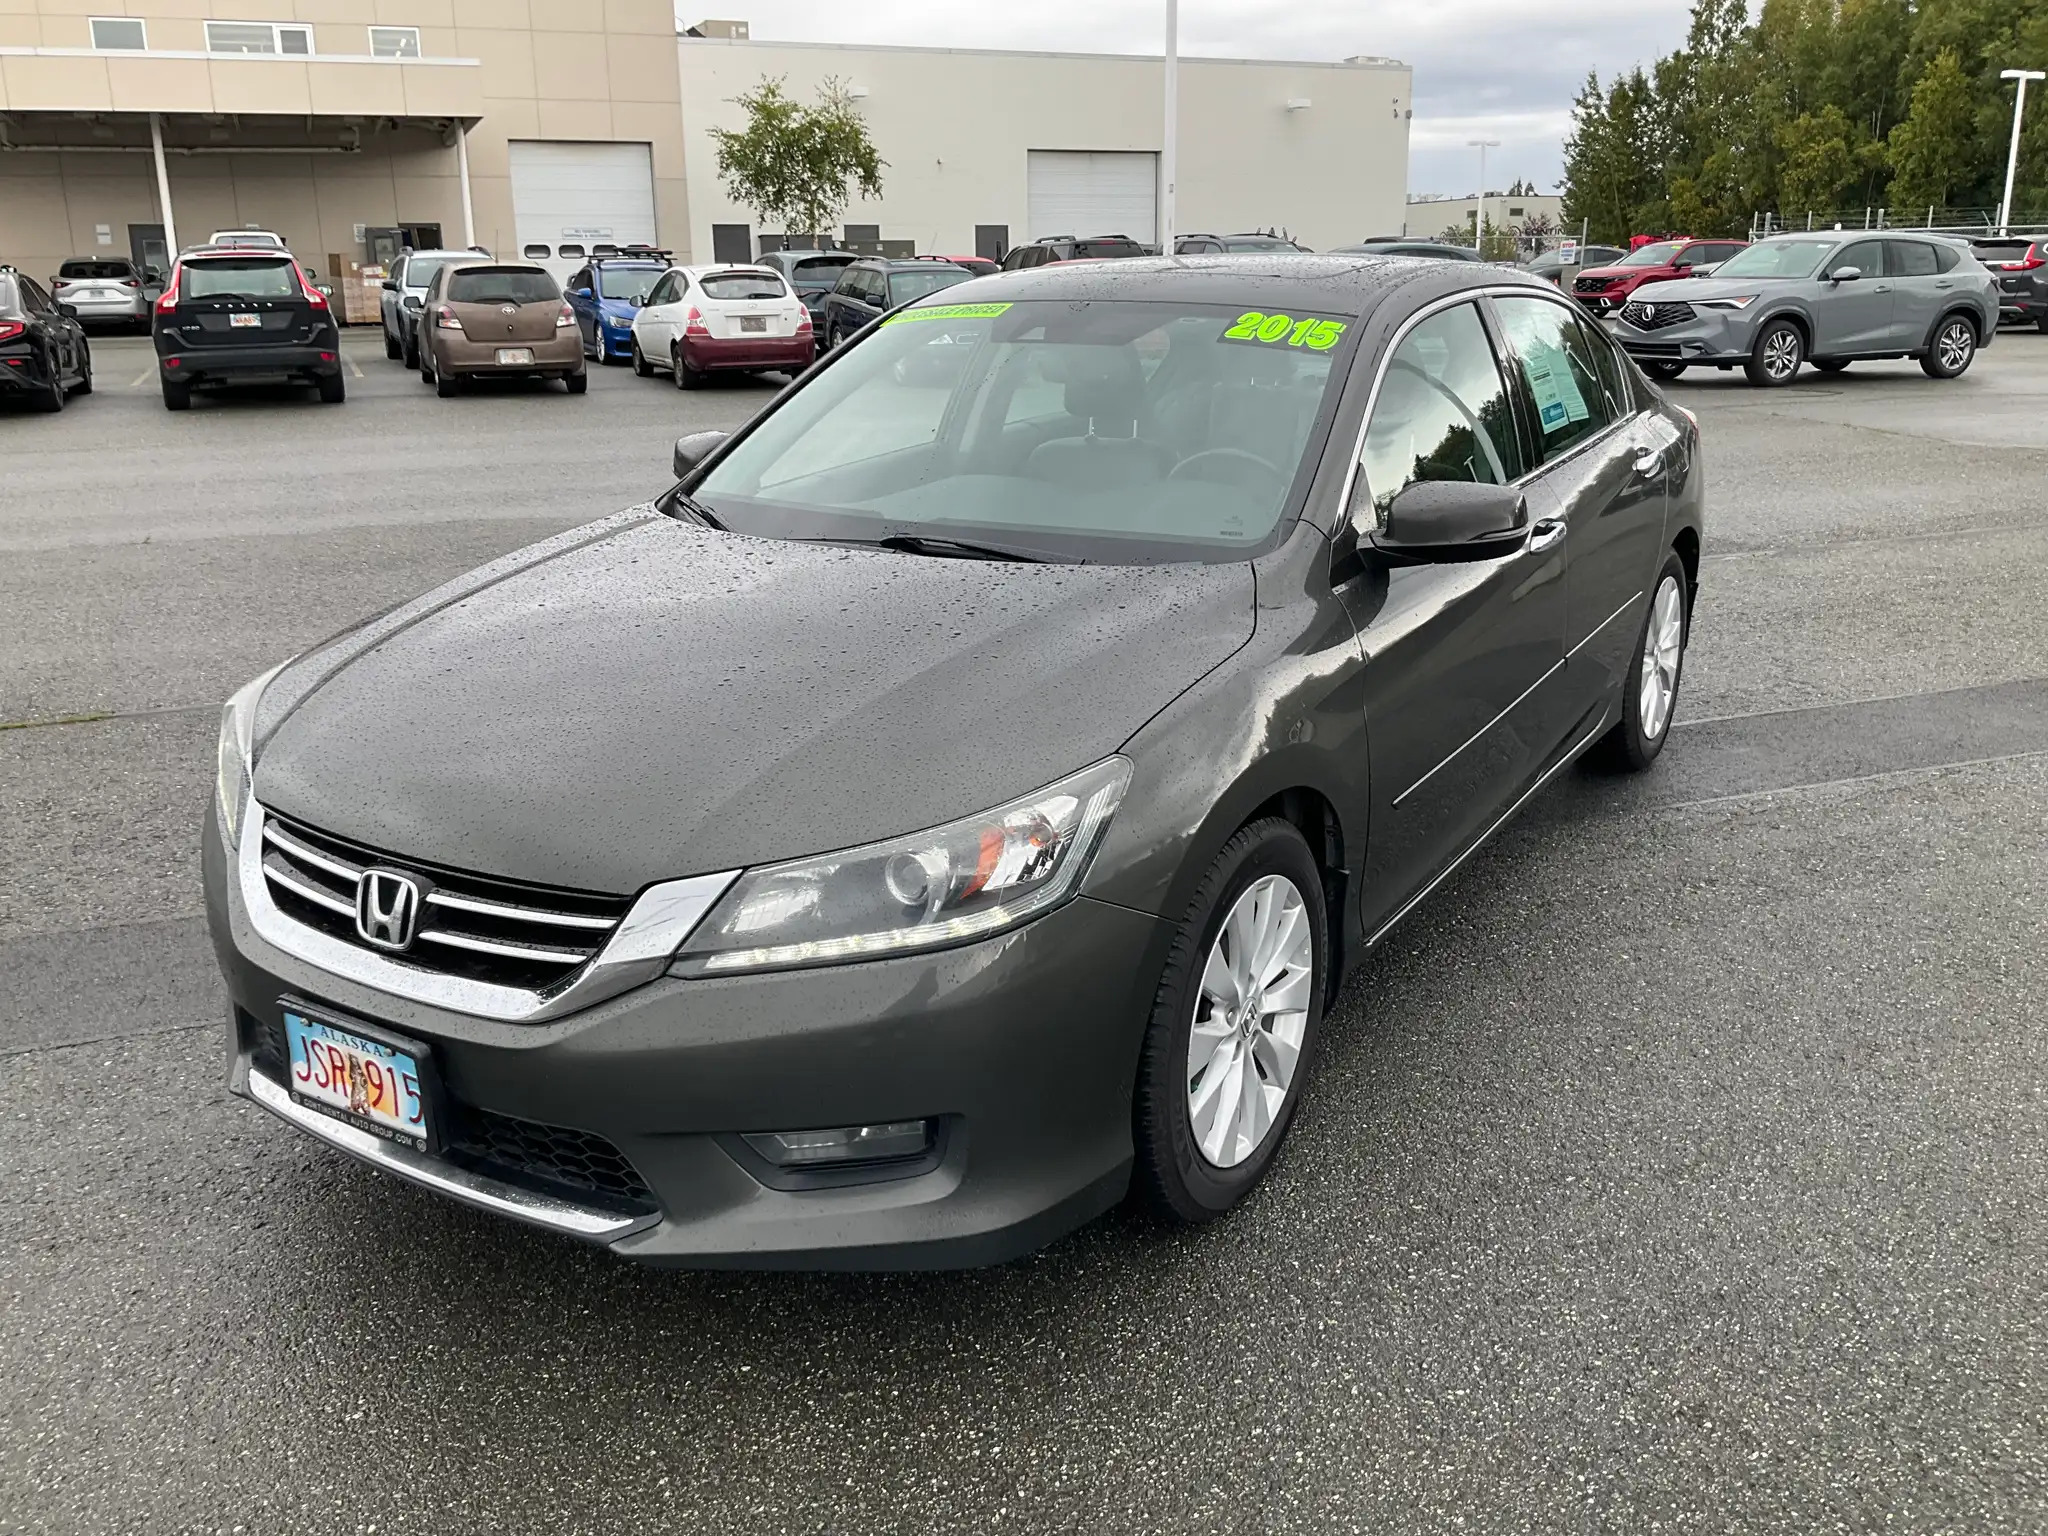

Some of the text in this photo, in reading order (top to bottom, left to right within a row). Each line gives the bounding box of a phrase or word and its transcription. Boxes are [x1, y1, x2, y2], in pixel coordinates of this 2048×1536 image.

[1224, 312, 1347, 350] 2015
[320, 1028, 385, 1057] ALASKA
[296, 1035, 424, 1124] JSR 915
[350, 1116, 369, 1129] AUTO
[369, 1124, 394, 1139] GROUP
